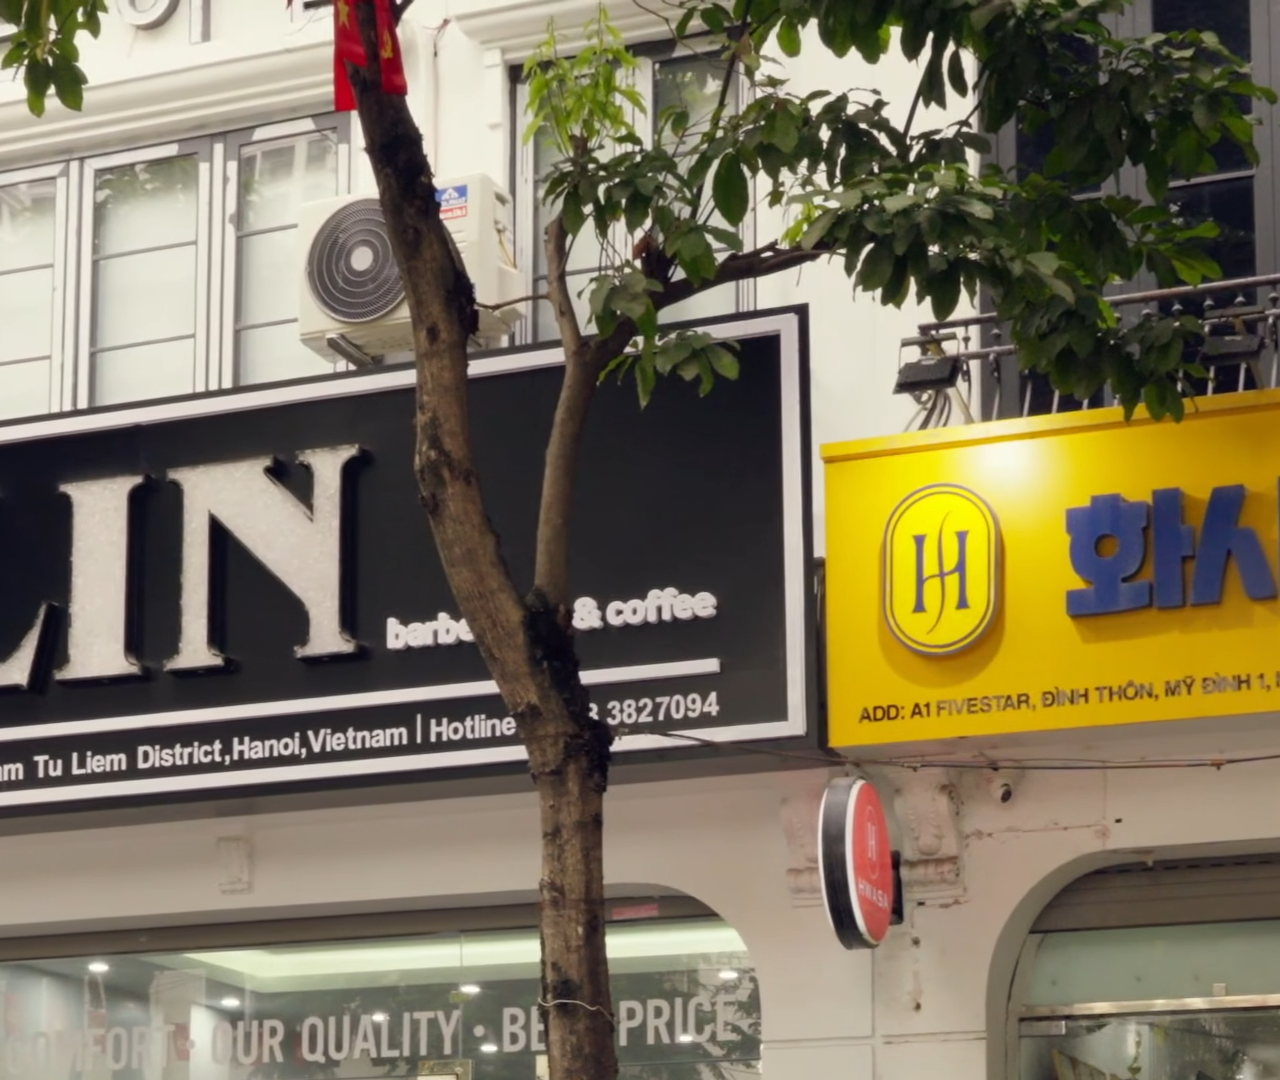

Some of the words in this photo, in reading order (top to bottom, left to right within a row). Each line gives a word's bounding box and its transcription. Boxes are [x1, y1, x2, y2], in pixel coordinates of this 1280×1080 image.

[572, 597, 604, 630] &
[606, 587, 717, 626] coffee
[859, 704, 905, 723] ADD:
[910, 703, 931, 719] A1
[936, 692, 1036, 717] FIVESTAR,
[1041, 686, 1089, 708] ĐÌNH
[1095, 679, 1159, 703] THÔN,
[1164, 676, 1196, 697] MỸ
[1201, 671, 1251, 694] ĐÌNH
[33, 754, 63, 778] Tu
[71, 747, 127, 775] Liem
[430, 713, 517, 742] Hotline
[606, 691, 720, 726] 3827094
[858, 878, 889, 909] HWASA
[211, 1018, 285, 1064] OUR
[300, 1009, 461, 1063] QUALITY
[618, 995, 748, 1046] PRICE
